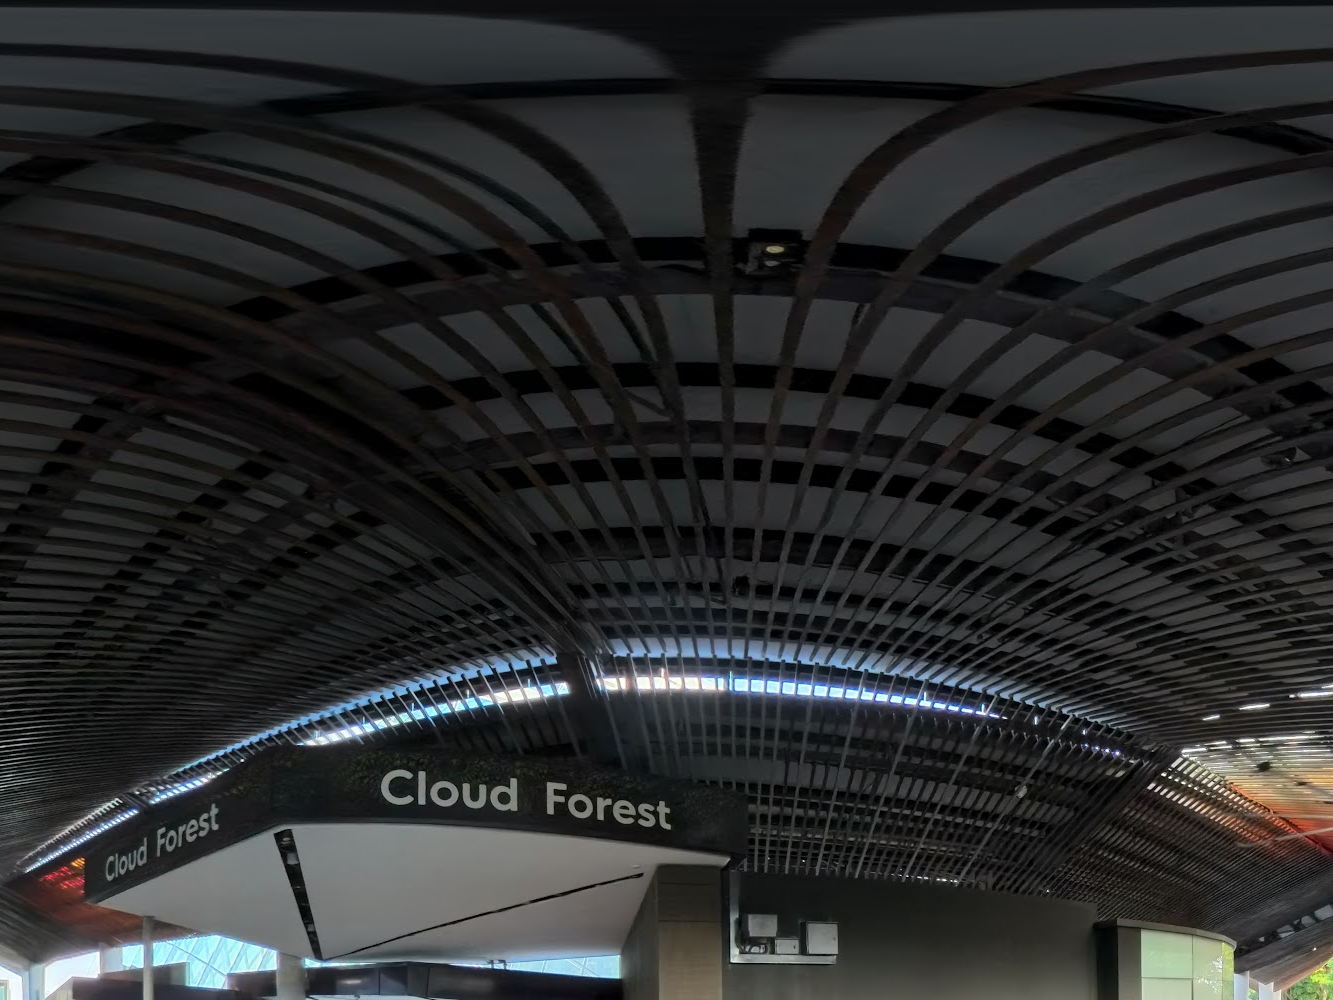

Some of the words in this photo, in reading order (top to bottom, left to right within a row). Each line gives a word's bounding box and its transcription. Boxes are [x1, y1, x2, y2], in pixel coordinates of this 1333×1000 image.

[380, 768, 519, 812] Cloud
[545, 781, 672, 831] Forest
[104, 838, 148, 883] Cloud
[156, 803, 220, 856] Forest
